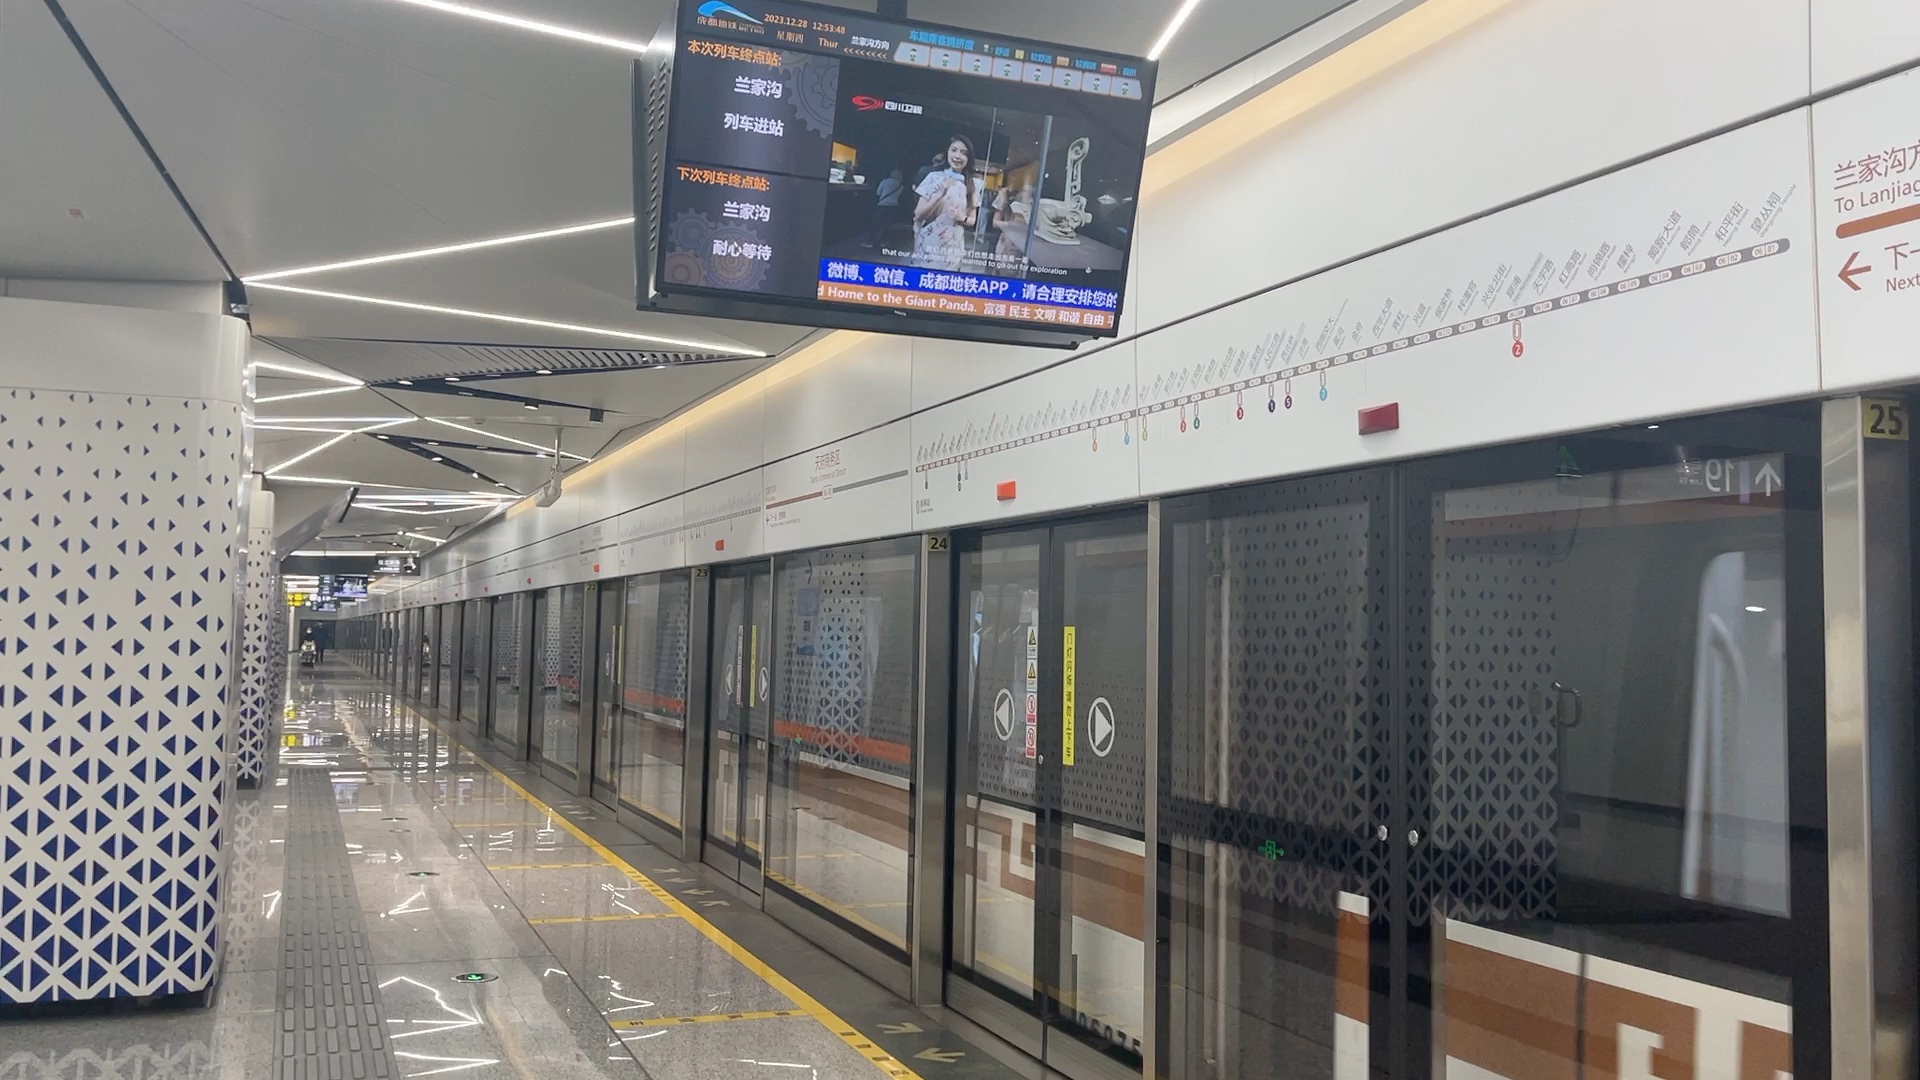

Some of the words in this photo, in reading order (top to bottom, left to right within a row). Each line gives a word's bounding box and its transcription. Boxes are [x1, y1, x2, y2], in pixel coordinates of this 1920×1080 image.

[764, 13, 809, 29] 2023.12.28
[812, 21, 846, 35] 12:53:48
[776, 30, 805, 44] 星期四
[818, 36, 839, 49] Thur
[851, 35, 890, 51] 兰家沟方向
[734, 75, 783, 99] 兰家沟
[723, 112, 785, 137] 列车进站
[722, 200, 771, 222] 兰家沟
[1834, 196, 1855, 214] To
[1714, 200, 1744, 242] 和平街
[712, 239, 773, 261] 耐心等待
[882, 247, 897, 257] that
[1029, 265, 1068, 276] exploration
[827, 286, 864, 301] Home
[867, 291, 880, 302] to
[883, 291, 902, 304] the
[904, 293, 937, 308] Giant
[939, 297, 977, 313] Panda.
[983, 302, 1006, 317] 富强
[1009, 305, 1031, 319] 民主
[1034, 307, 1057, 321] 文明
[1058, 310, 1081, 324] 和谐
[1083, 312, 1105, 326] 自由
[1870, 403, 1903, 436] 25
[930, 536, 948, 550] 24
[696, 568, 709, 578] 23
